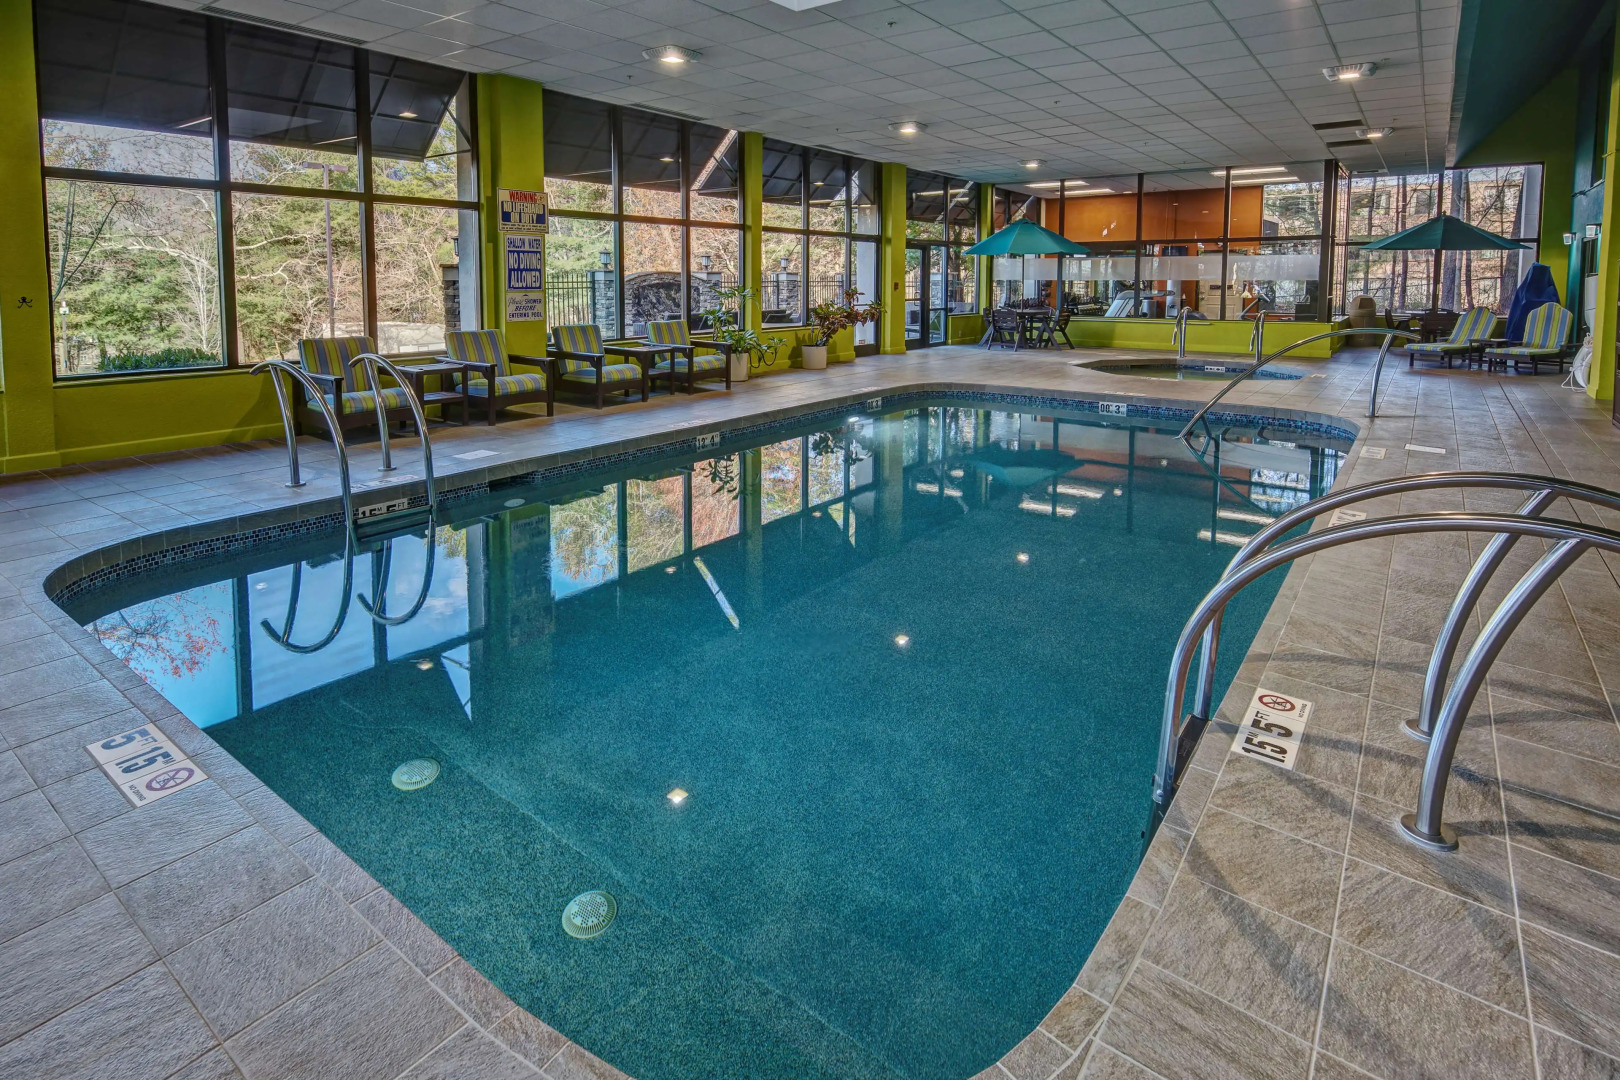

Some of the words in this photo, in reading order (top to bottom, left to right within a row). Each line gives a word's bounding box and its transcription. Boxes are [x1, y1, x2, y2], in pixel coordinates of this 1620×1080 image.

[509, 190, 537, 203] WARNING
[503, 202, 512, 212] NO
[513, 202, 543, 215] LIFEGUARD
[511, 212, 519, 223] ON
[521, 213, 537, 224] DUTY
[507, 237, 525, 249] SHALLOW
[528, 238, 541, 249] WATER
[509, 252, 518, 269] NO
[520, 252, 541, 269] DIVING
[510, 271, 540, 288] ALLOWED
[1254, 711, 1270, 720] FT
[1251, 718, 1293, 738] 5
[100, 728, 151, 750] 5
[137, 736, 158, 747] FT
